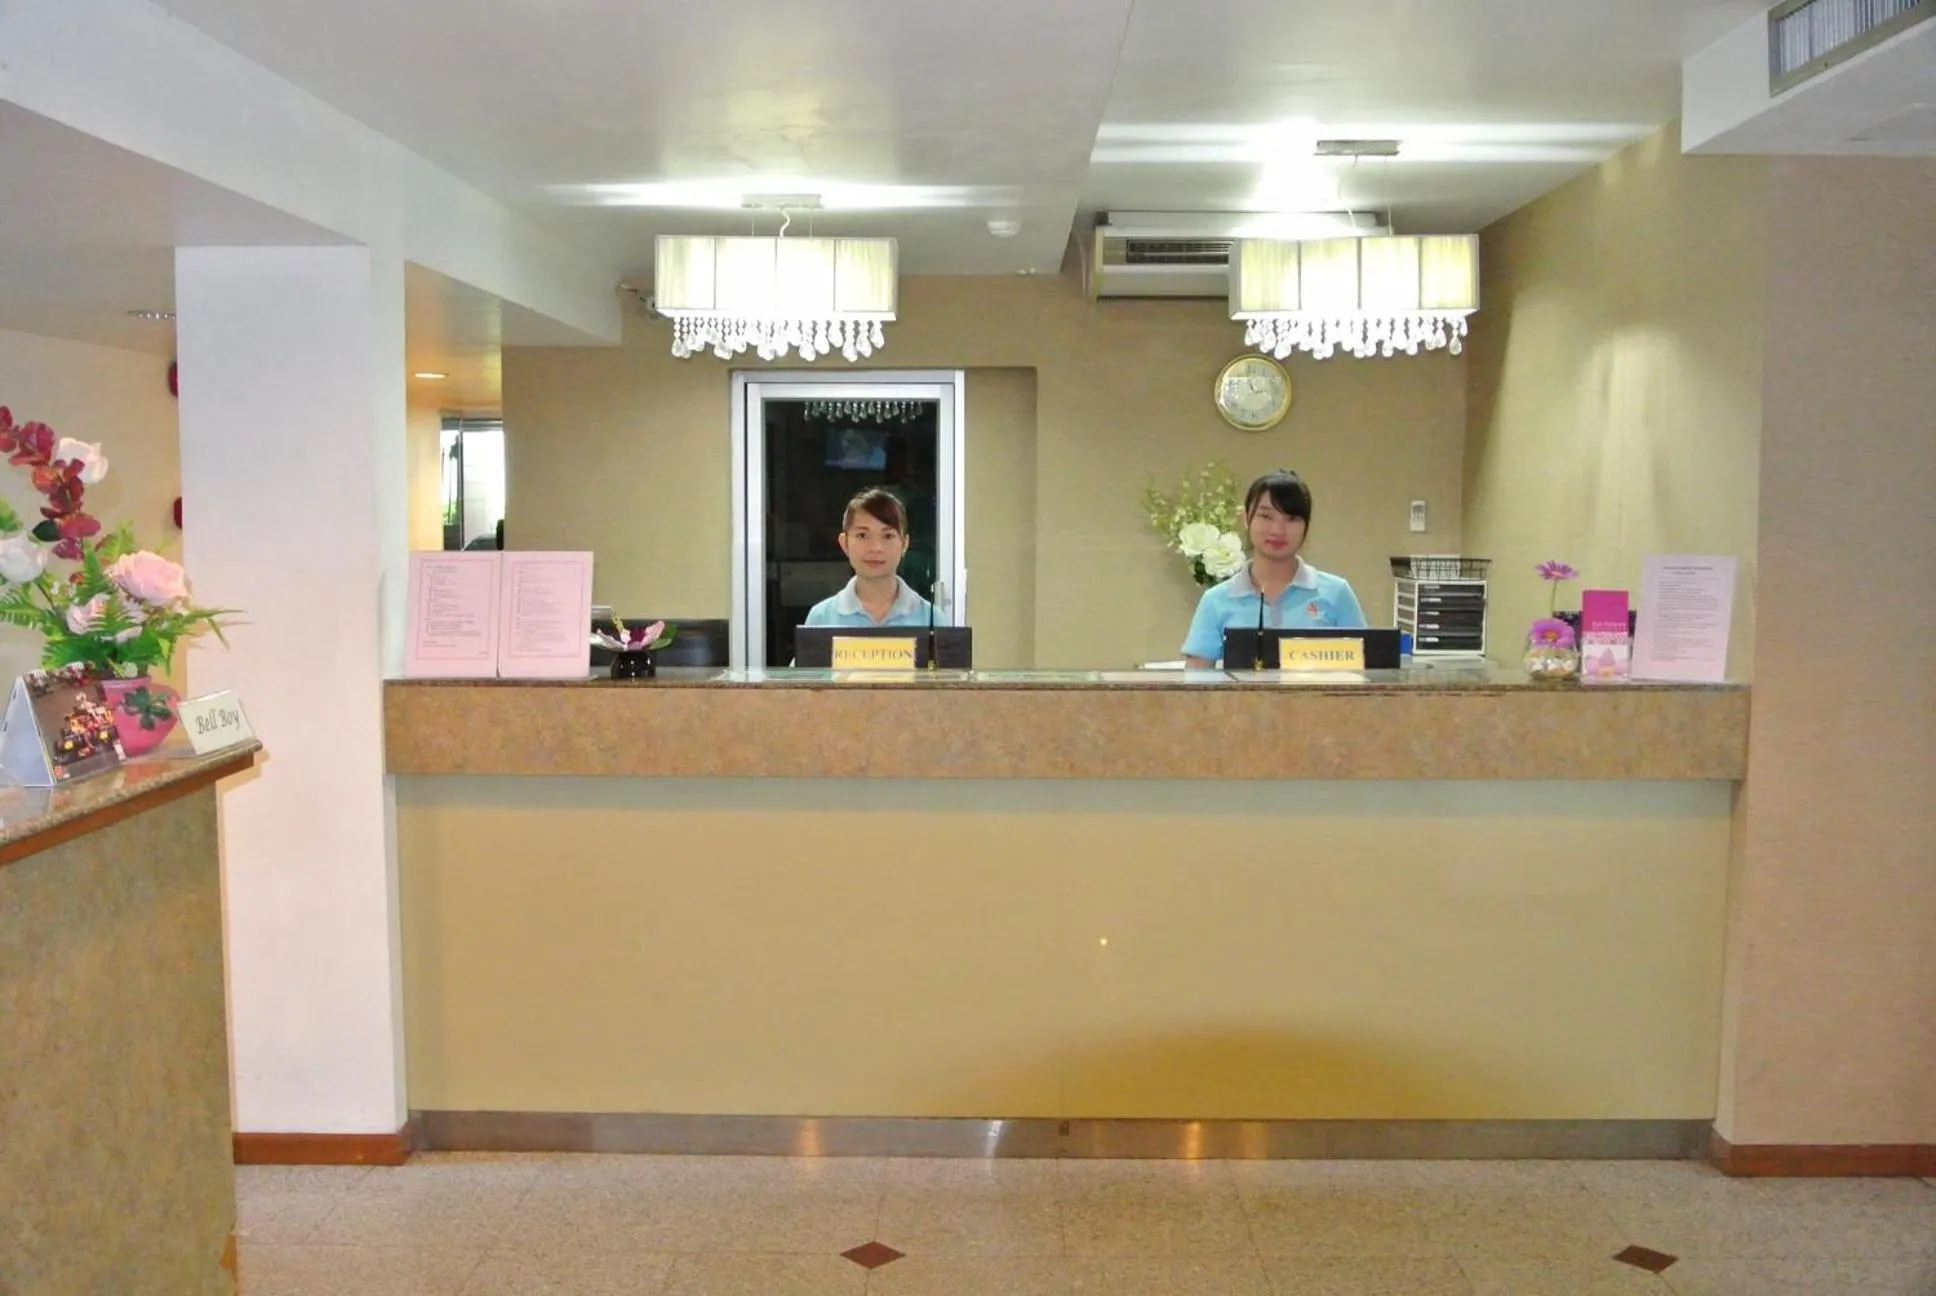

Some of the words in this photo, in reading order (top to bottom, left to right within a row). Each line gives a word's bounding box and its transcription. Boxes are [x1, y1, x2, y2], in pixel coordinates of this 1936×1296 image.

[834, 648, 914, 660] RECEPTION
[1288, 649, 1355, 661] CASHIER
[195, 708, 218, 735] Bell
[218, 708, 240, 731] Boy
